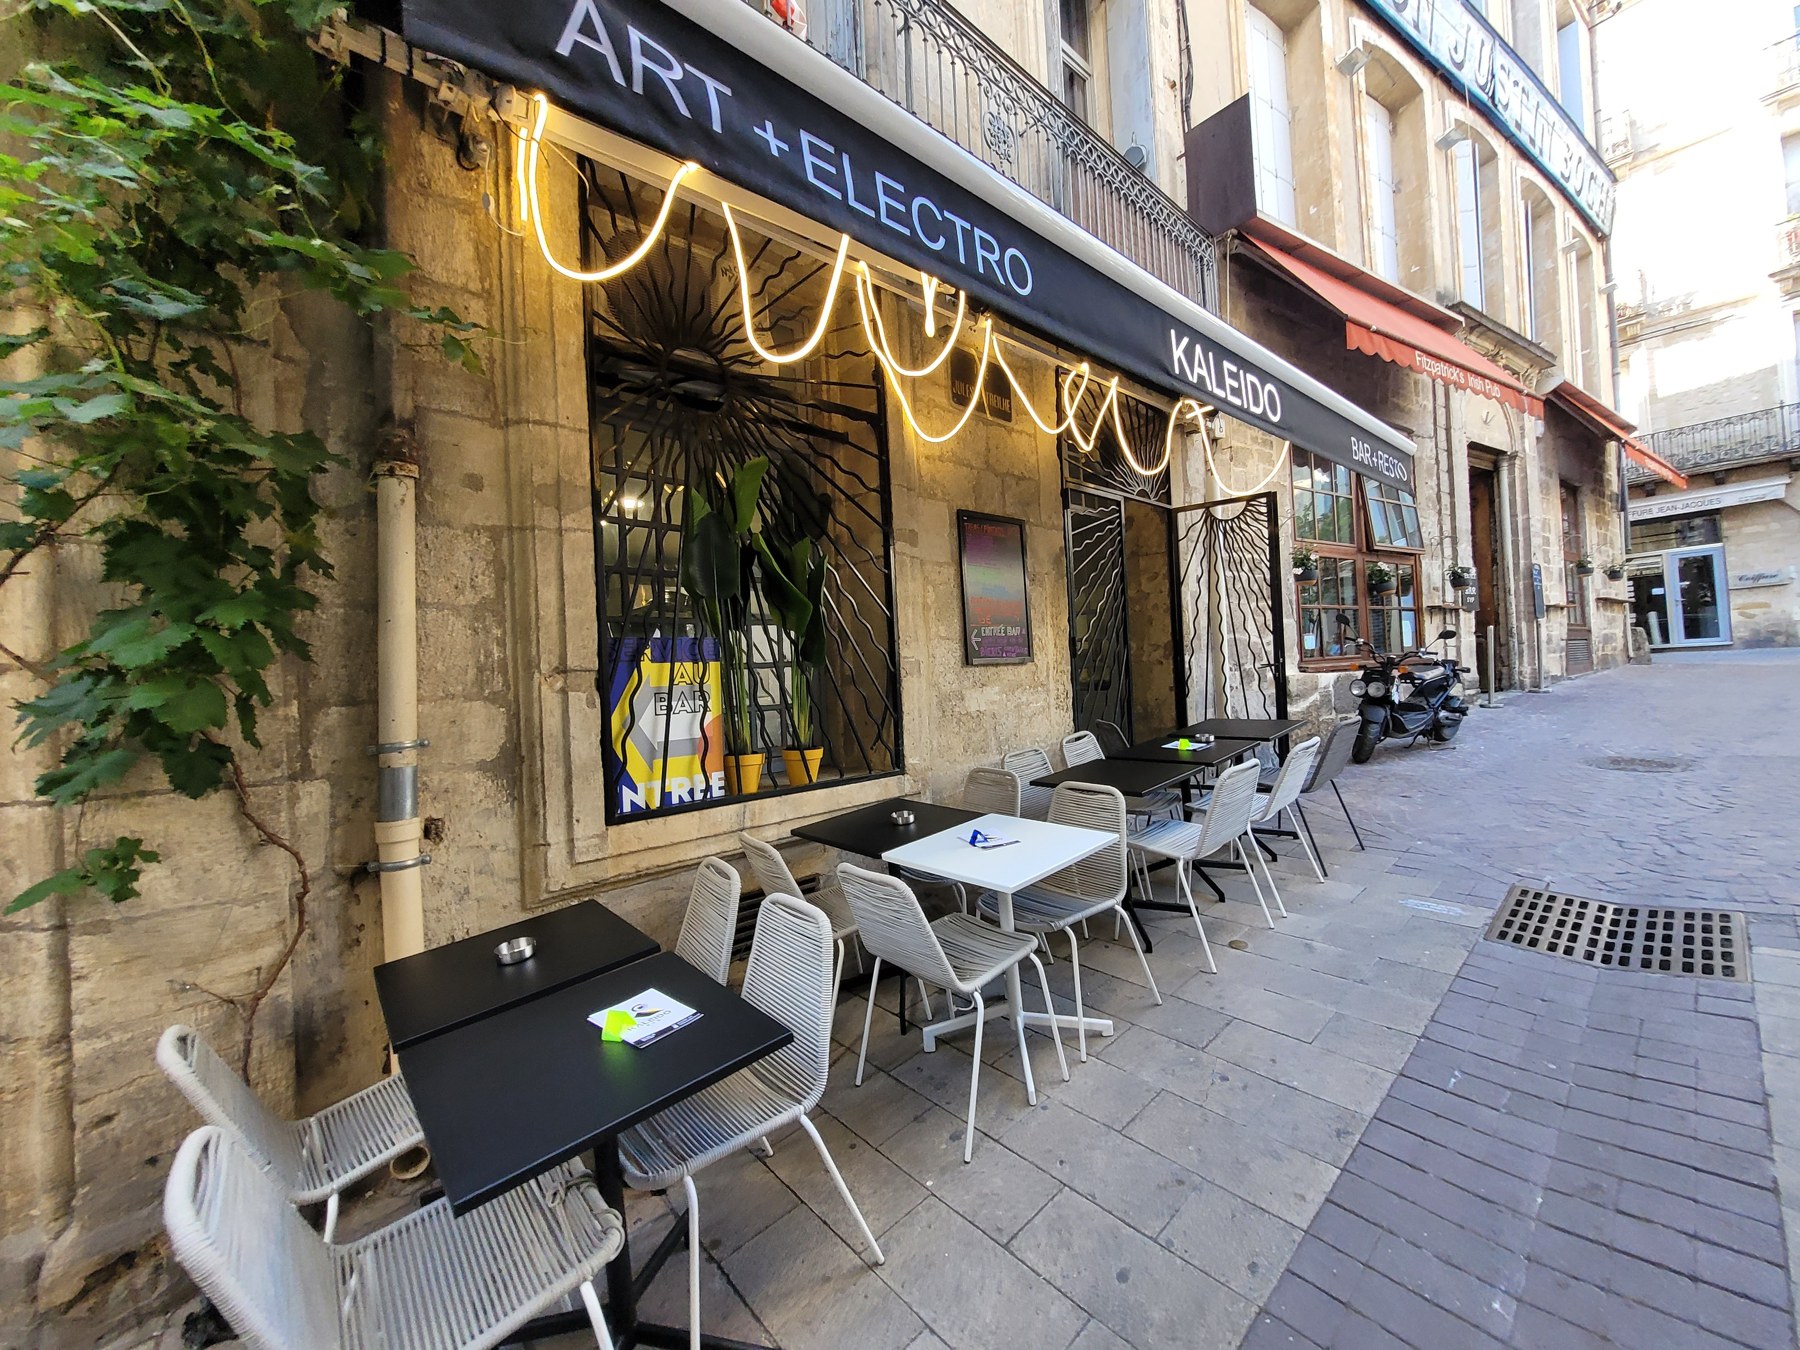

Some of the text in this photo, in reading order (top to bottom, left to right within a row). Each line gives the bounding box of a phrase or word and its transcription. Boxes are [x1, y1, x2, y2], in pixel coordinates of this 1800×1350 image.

[555, 0, 732, 134] ART
[1169, 328, 1281, 422] KALEIDO
[1415, 350, 1501, 398] Fitzpatrick's Irish Pub
[1655, 497, 1722, 514] JEAN-JACQUES
[673, 661, 711, 686] AU
[654, 689, 712, 716] BAR
[617, 771, 726, 814] NTREE
